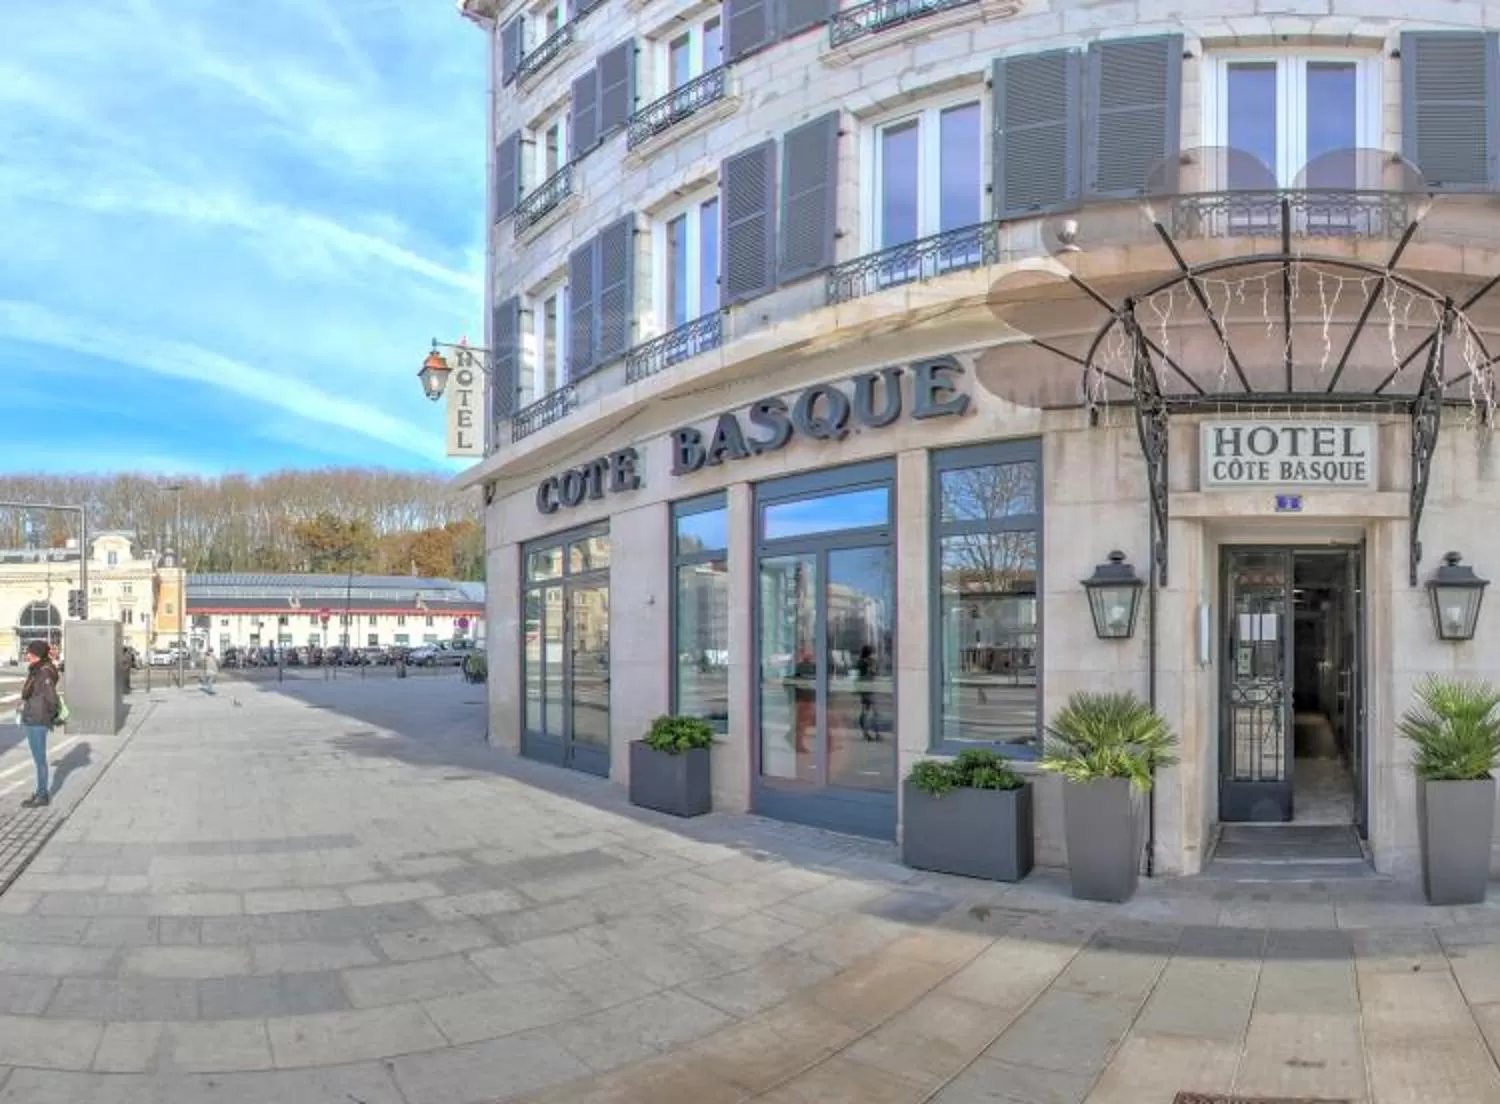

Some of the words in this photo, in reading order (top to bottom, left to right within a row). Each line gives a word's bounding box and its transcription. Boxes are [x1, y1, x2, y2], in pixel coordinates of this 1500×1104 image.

[455, 350, 473, 449] HOTEL
[670, 354, 971, 476] BASQUE
[1212, 426, 1365, 457] HOTEL
[1212, 458, 1270, 480] CÔTE
[1280, 460, 1366, 482] BASQUE
